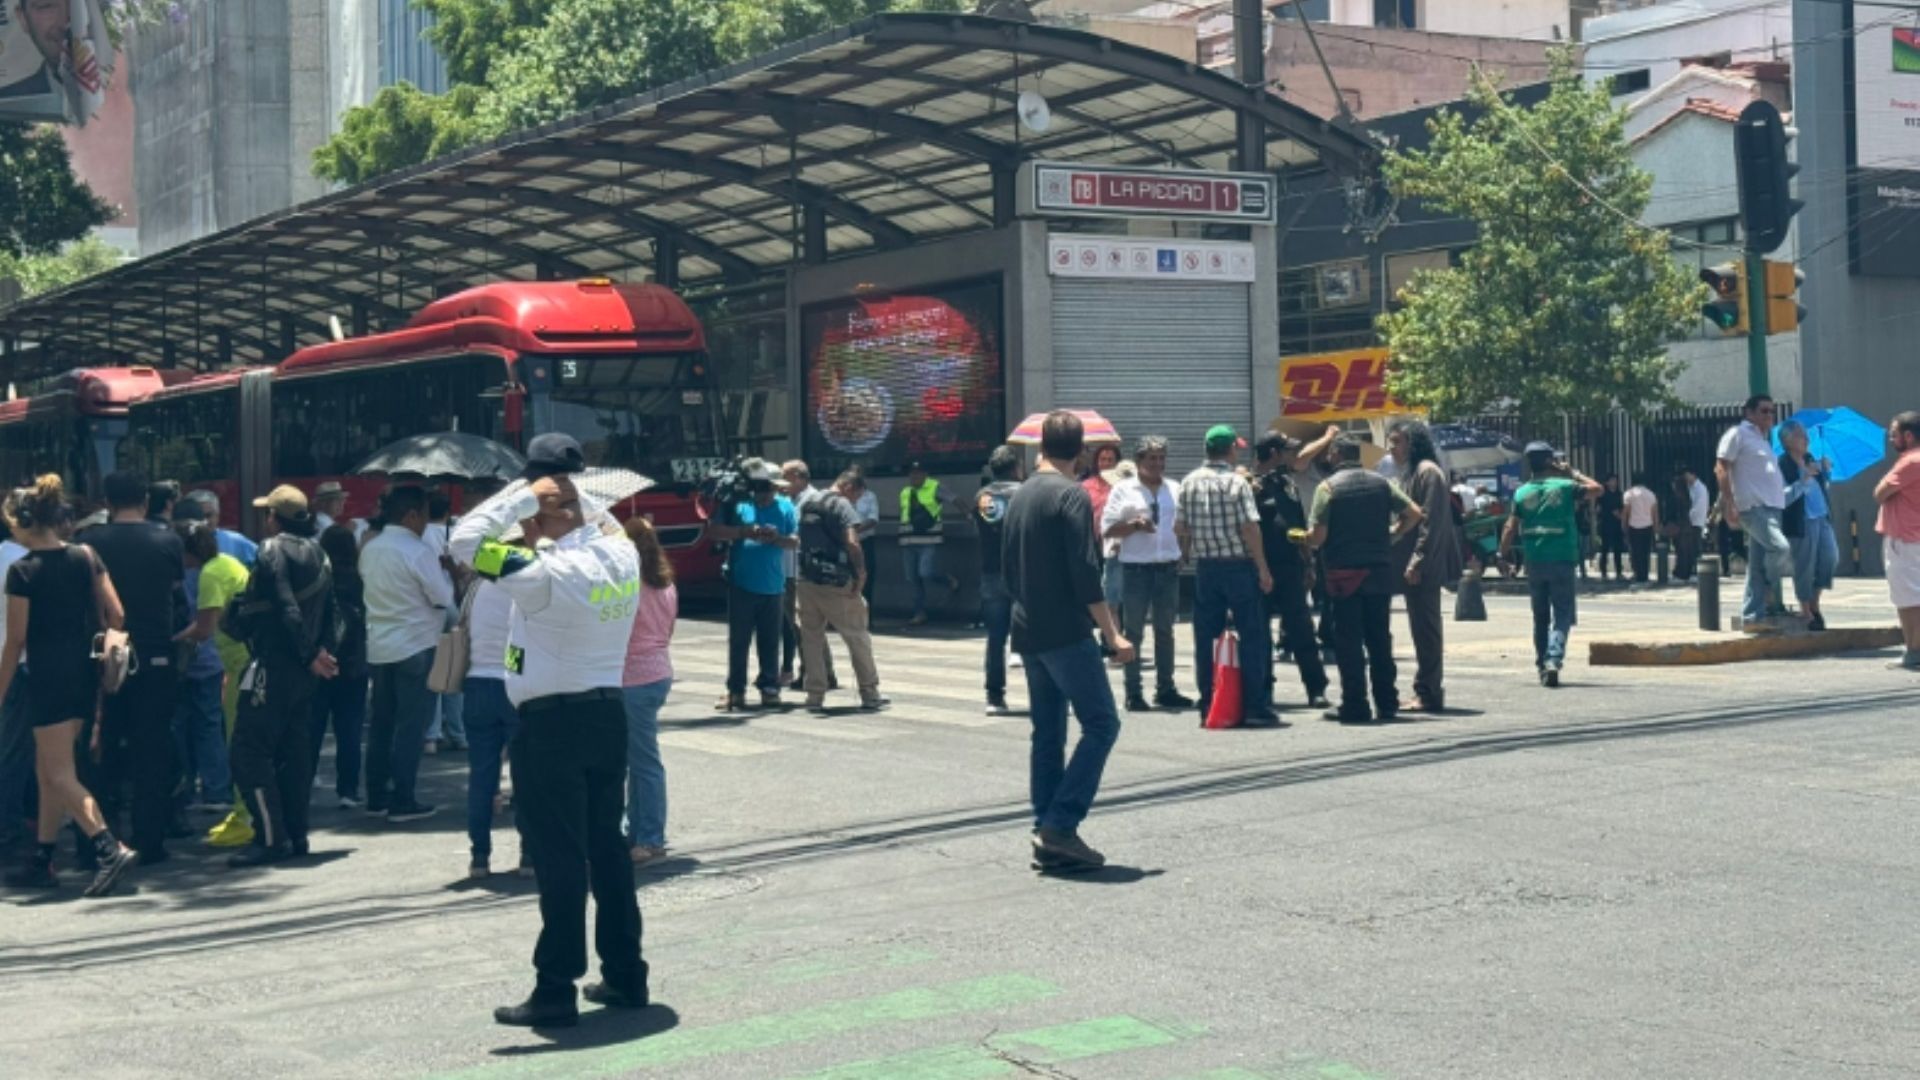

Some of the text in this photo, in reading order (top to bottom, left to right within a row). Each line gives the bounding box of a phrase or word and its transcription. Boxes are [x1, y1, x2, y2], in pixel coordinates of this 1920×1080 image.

[1109, 180, 1134, 198] LA
[1221, 186, 1230, 207] 1
[1283, 357, 1404, 416] DH
